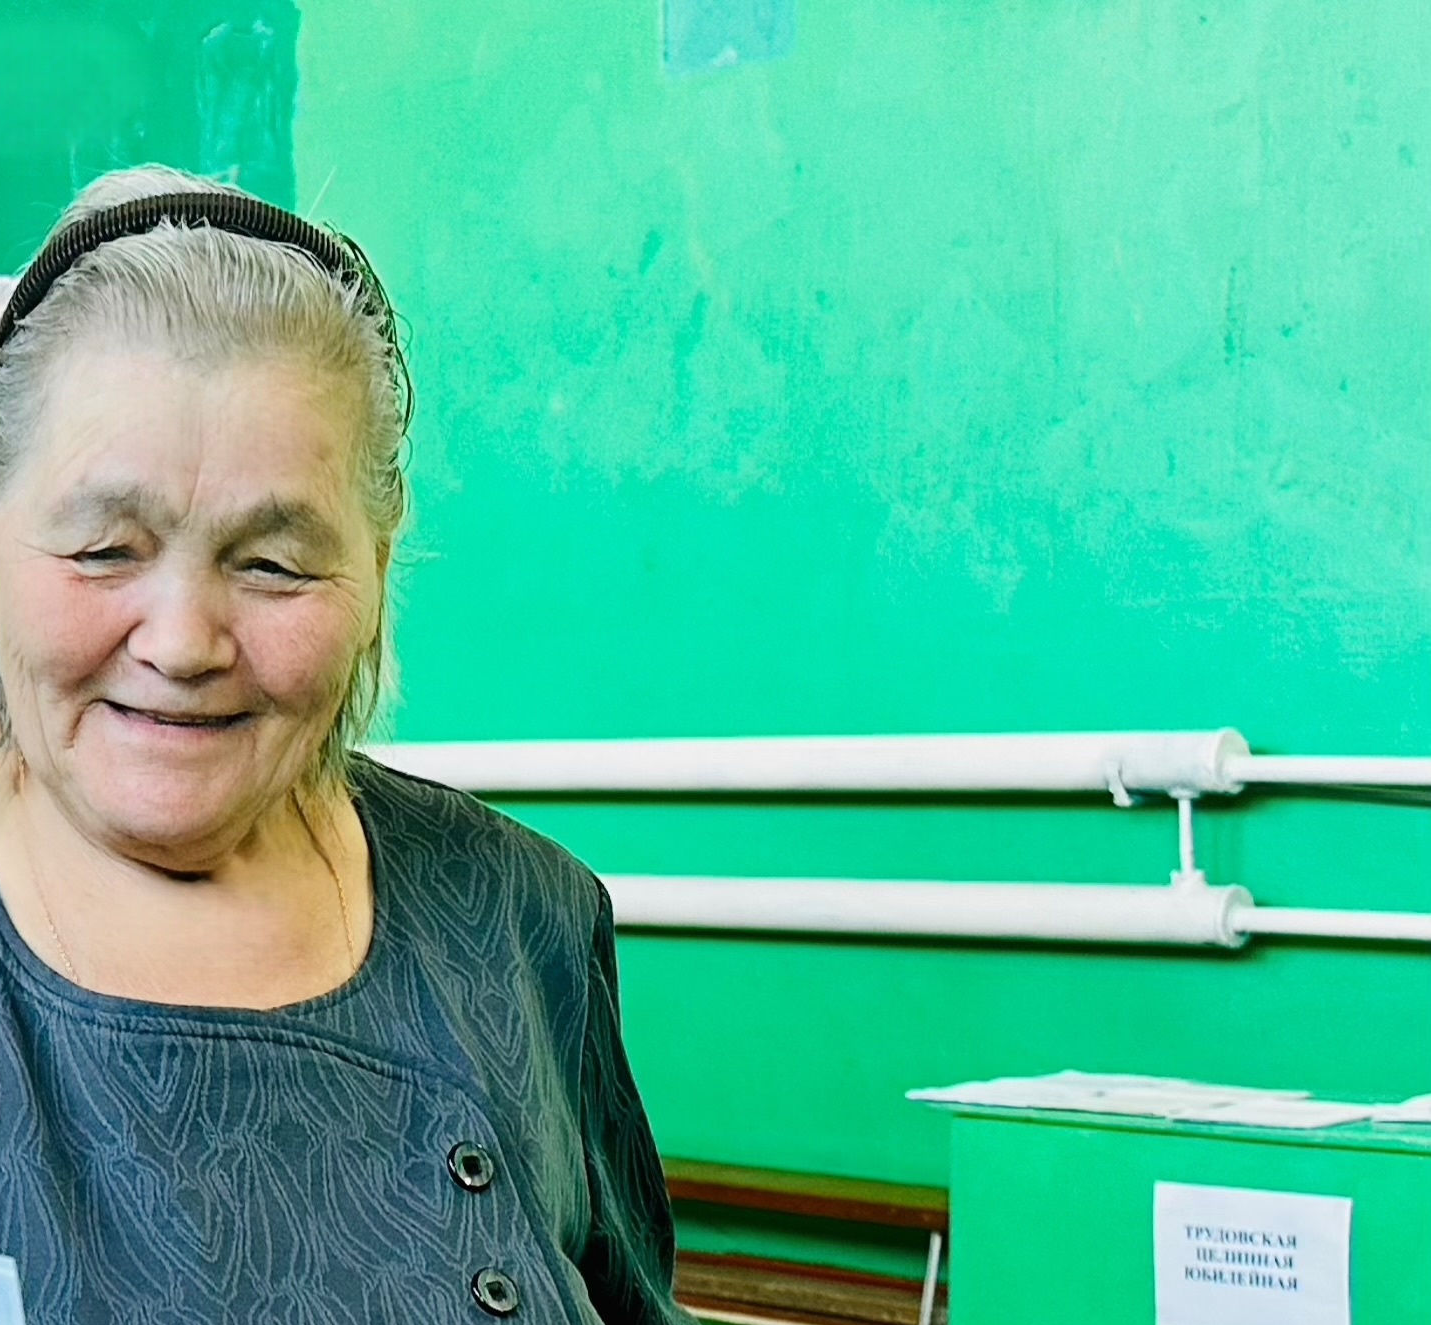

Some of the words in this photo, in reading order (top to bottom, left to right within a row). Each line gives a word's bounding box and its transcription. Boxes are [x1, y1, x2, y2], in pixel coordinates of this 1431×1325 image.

[1184, 1224, 1298, 1250] ТРУДОВСКАЯ
[1196, 1246, 1294, 1269] ЦЕЛИННАЯ
[1184, 1266, 1298, 1291] ЮБИЛЕЙНАЯ
